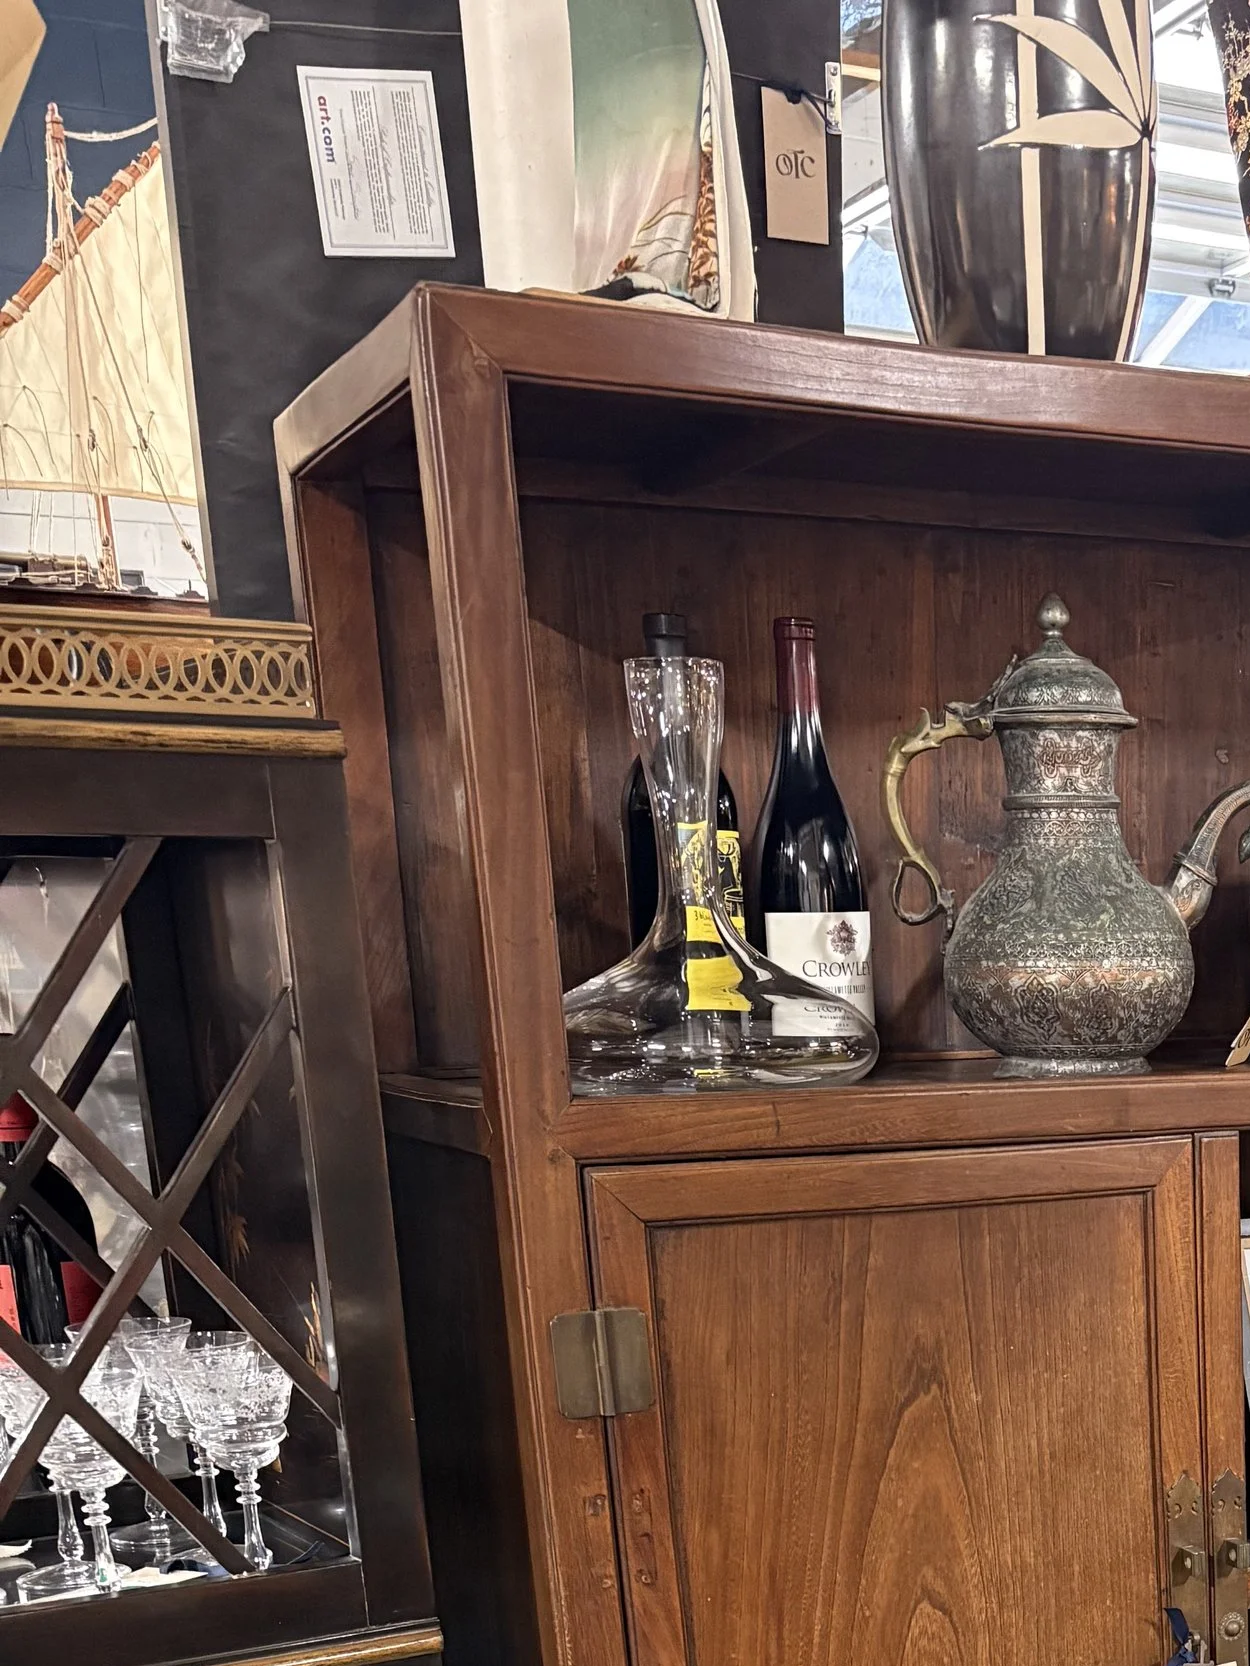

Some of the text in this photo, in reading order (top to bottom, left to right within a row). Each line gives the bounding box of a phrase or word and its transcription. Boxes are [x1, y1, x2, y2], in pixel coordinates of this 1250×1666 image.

[317, 95, 336, 163] art.com
[775, 149, 816, 179] OTC
[802, 960, 871, 977] CROWLEY
